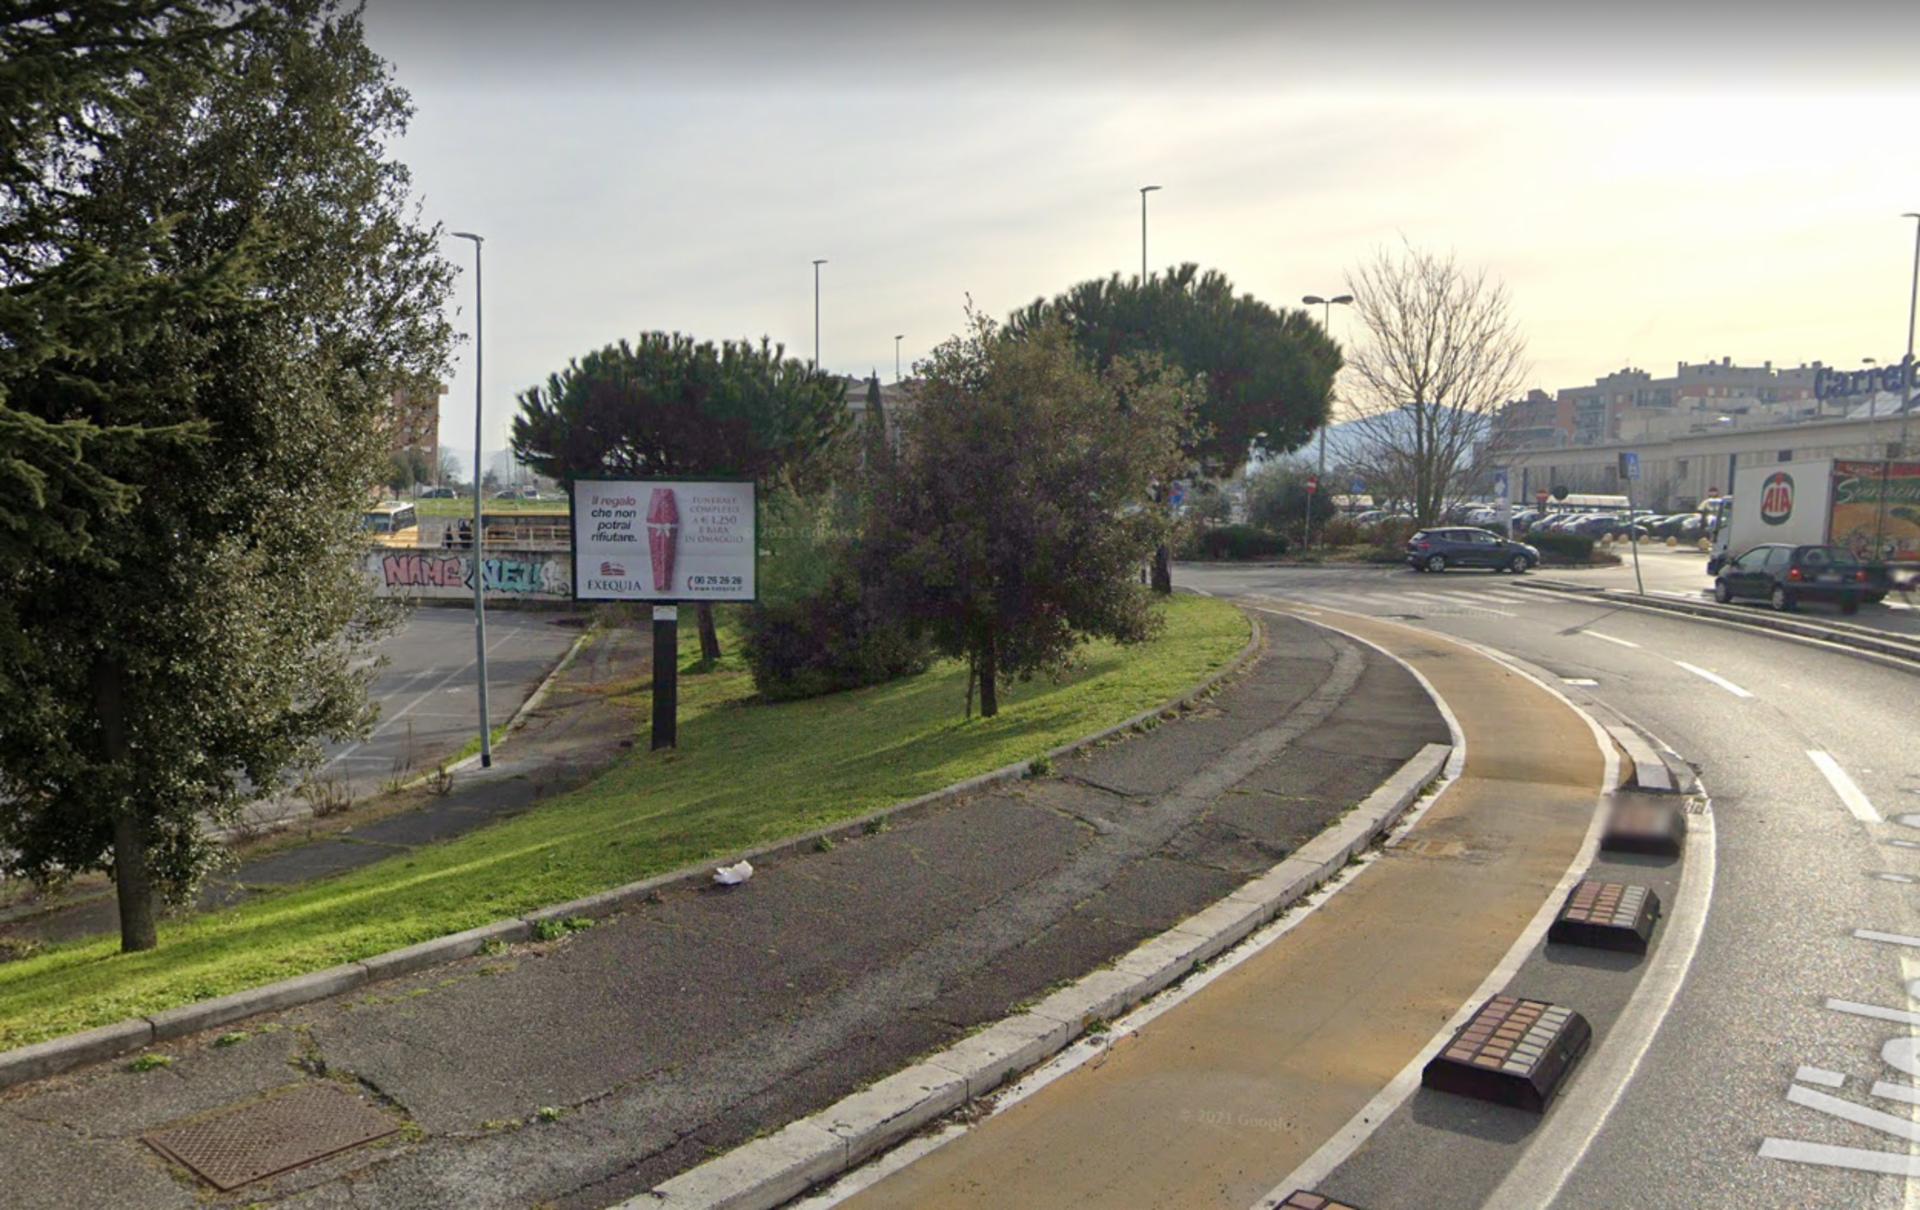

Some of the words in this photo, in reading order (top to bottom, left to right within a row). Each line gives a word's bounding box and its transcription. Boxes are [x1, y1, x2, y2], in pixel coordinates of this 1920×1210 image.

[1761, 473, 1792, 513] AIA
[600, 495, 636, 508] regalo
[692, 496, 737, 504] FUNERALE
[591, 507, 612, 518] che
[614, 509, 637, 518] non
[689, 505, 741, 513] COMPLETO
[597, 520, 631, 531] potrai
[591, 531, 638, 542] rifiutare.
[684, 535, 696, 544] IN
[698, 535, 744, 544] OMAGGIO
[382, 554, 463, 588] NAME
[587, 579, 642, 593] EXEQUIA
